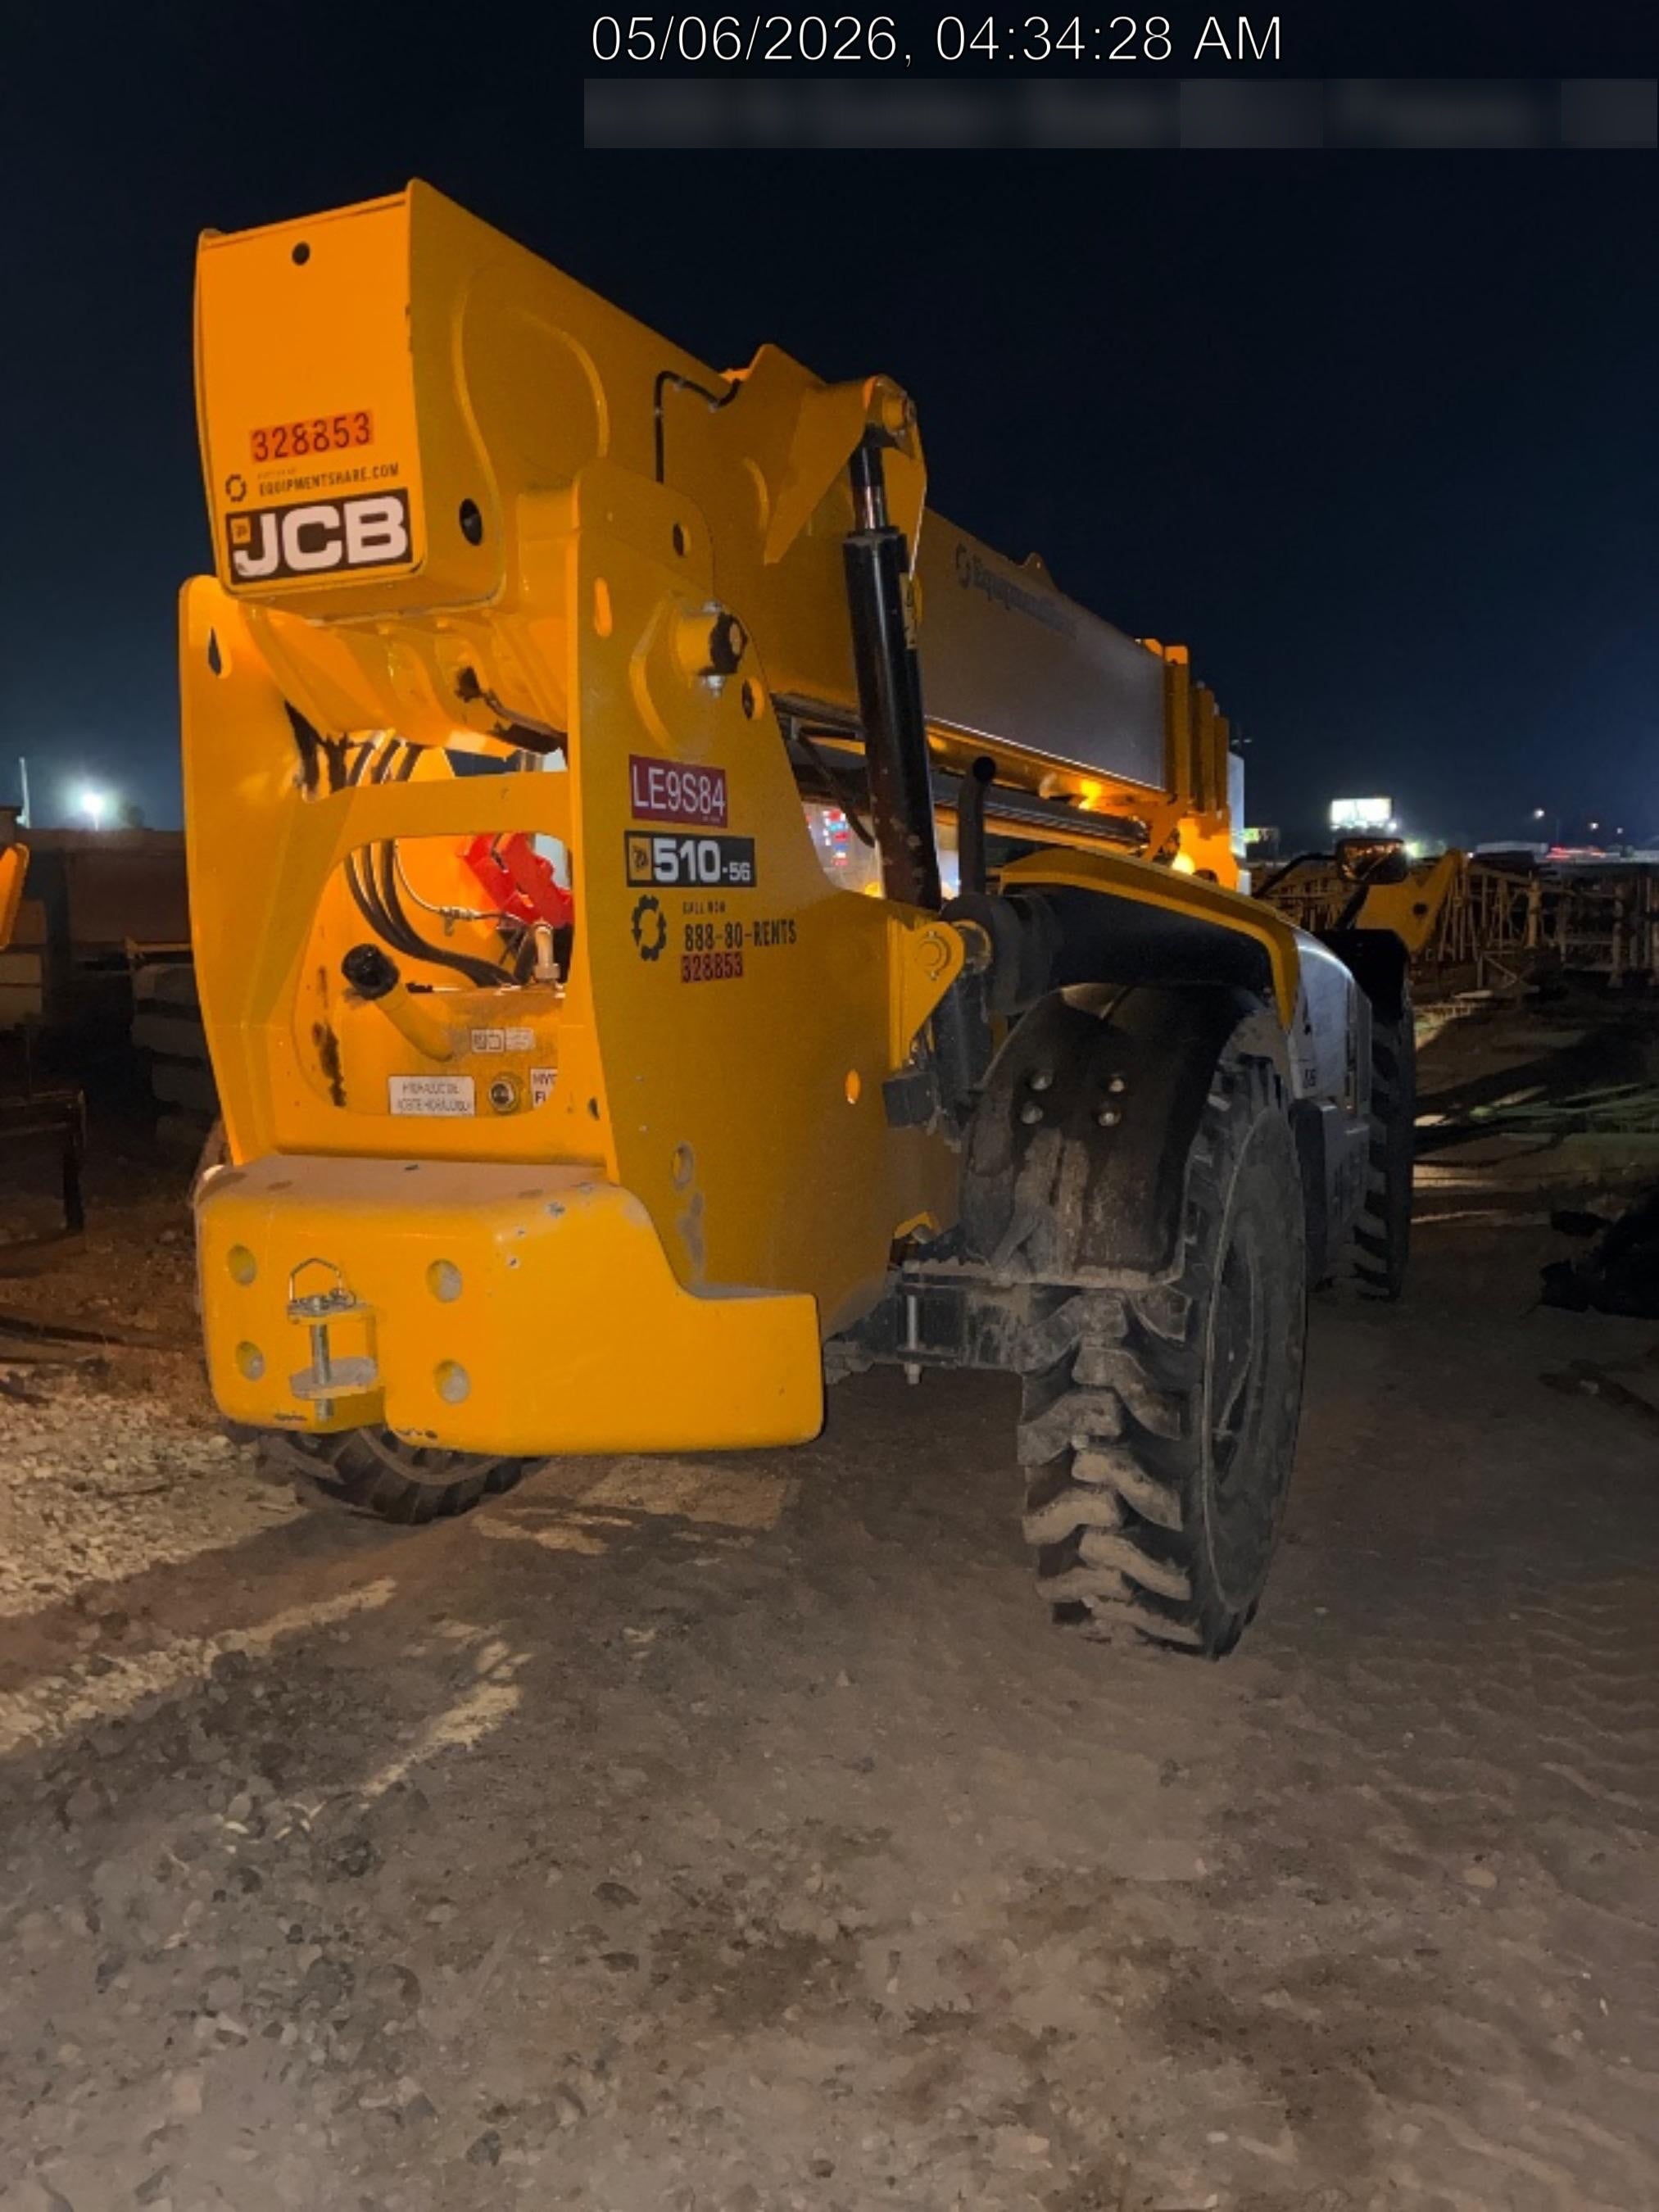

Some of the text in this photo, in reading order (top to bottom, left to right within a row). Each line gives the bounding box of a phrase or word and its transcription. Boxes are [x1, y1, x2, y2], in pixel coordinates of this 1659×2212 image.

[251, 411, 372, 463] 328853
[259, 462, 400, 496] EQUIPMENTSHARE.COM
[233, 495, 409, 578] JCB
[632, 764, 726, 818] LE9S84
[684, 918, 797, 952] 888-80-RENTS
[681, 951, 743, 983] 328853
